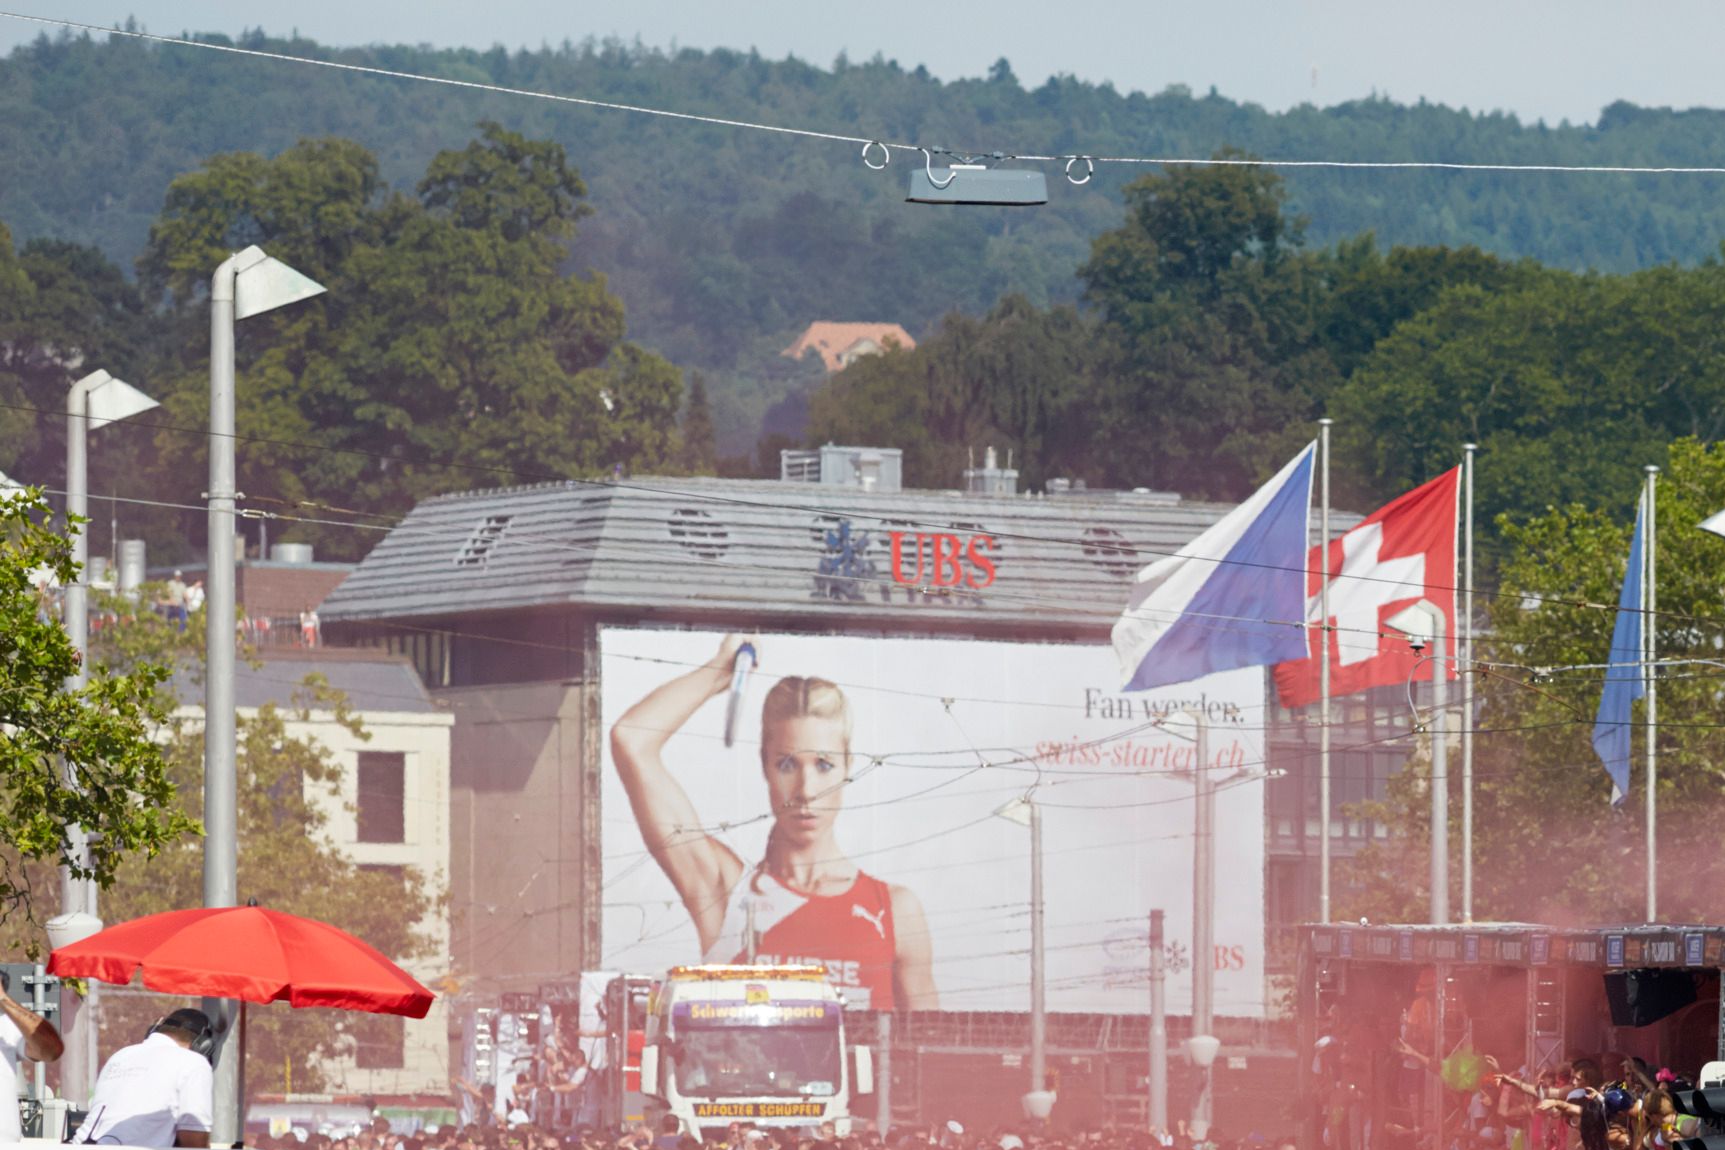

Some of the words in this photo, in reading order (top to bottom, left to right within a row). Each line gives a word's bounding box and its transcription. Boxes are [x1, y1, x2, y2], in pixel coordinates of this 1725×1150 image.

[889, 531, 996, 589] UBS
[1084, 688, 1134, 721] Fan
[1034, 735, 1246, 769] swiss-starter.ch
[1214, 944, 1245, 971] BS
